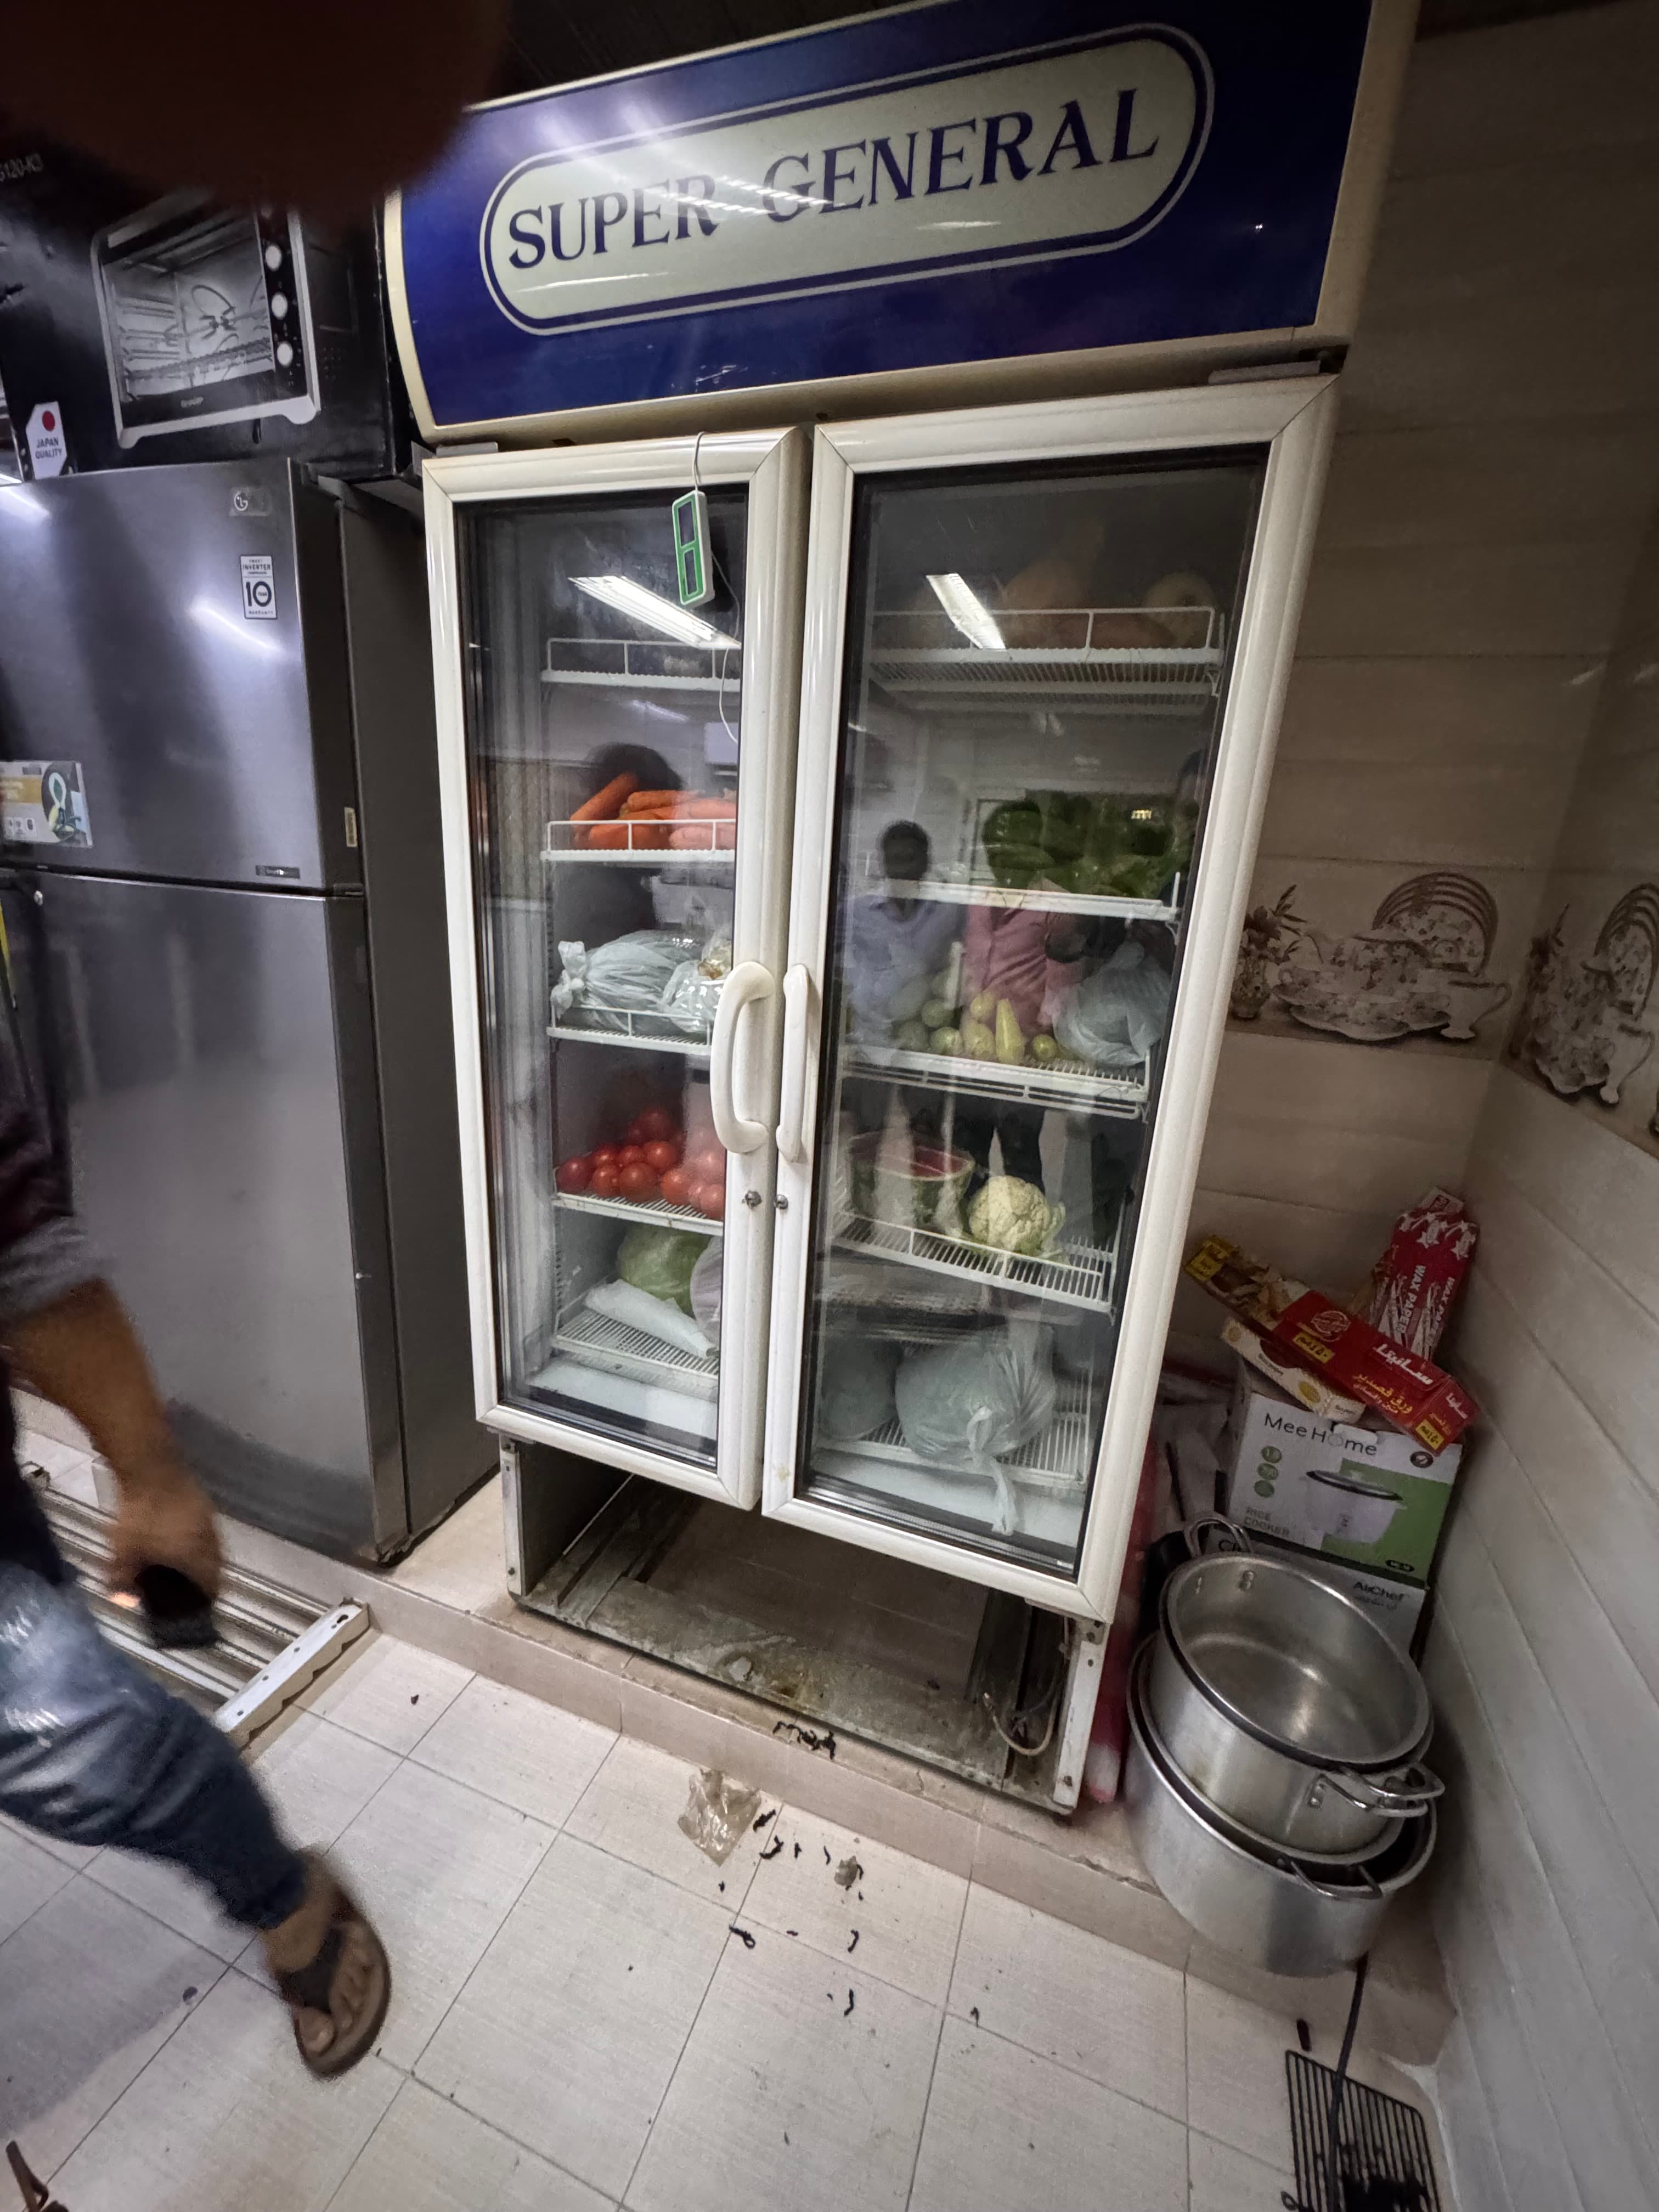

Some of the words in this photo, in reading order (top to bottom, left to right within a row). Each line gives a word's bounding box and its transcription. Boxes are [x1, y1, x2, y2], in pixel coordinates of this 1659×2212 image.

[509, 174, 718, 269] SUPER
[763, 88, 1159, 222] GENERAL
[35, 448, 62, 459] QUALITY
[36, 437, 59, 449] JAPAN
[246, 581, 272, 607] 10
[1410, 1265, 1426, 1292] WAX
[1396, 1292, 1418, 1334] PAPER
